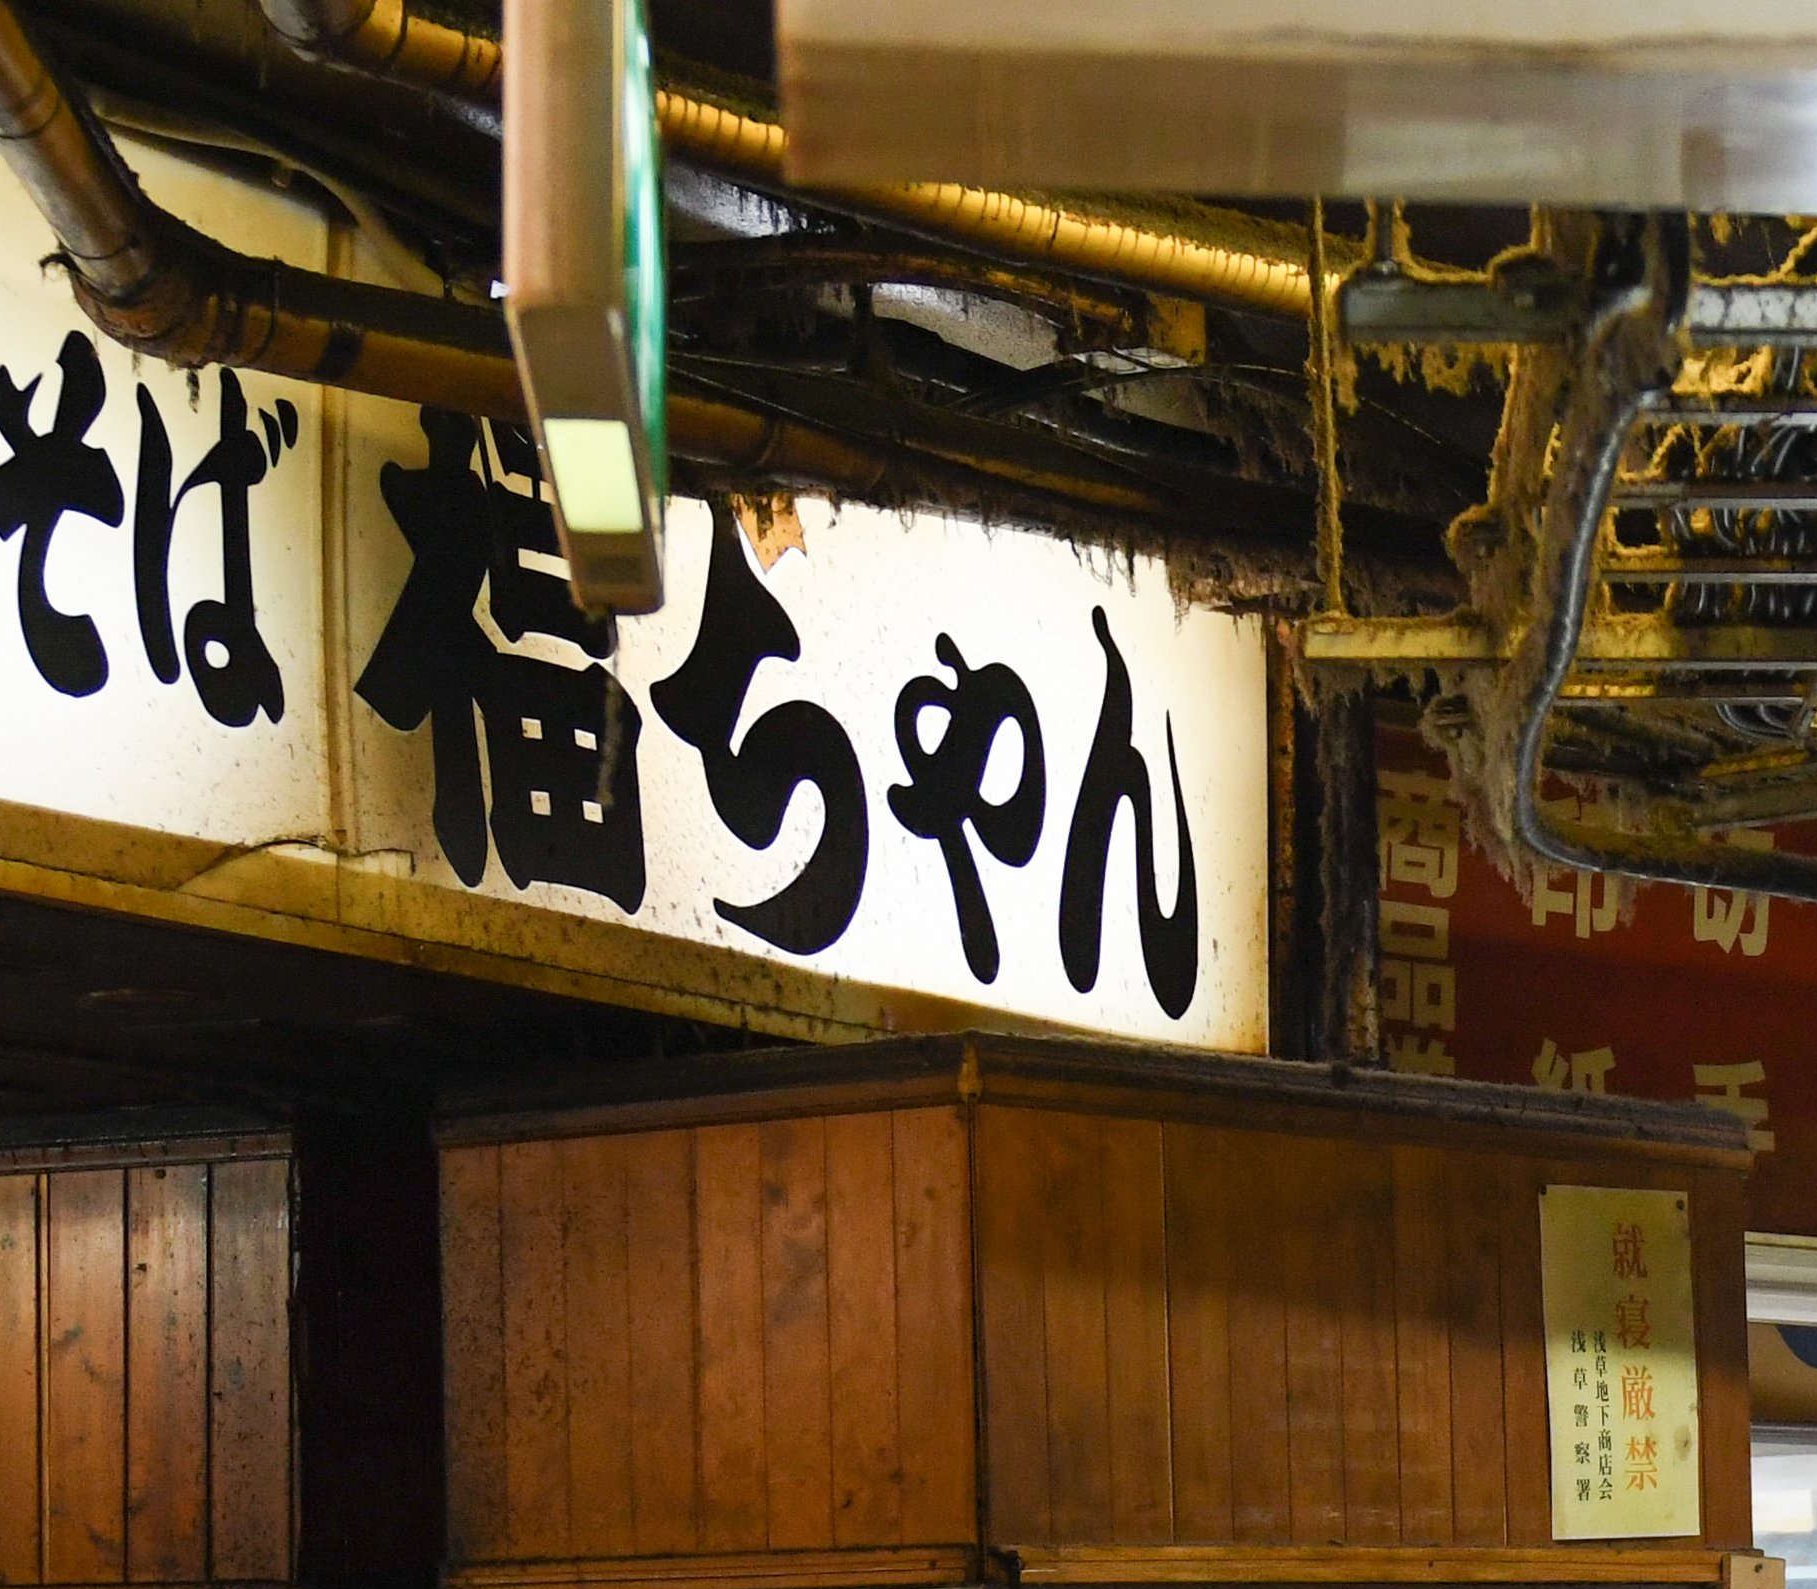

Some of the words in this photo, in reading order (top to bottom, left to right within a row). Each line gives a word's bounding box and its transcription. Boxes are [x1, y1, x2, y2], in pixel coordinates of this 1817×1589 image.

[353, 404, 1200, 1020] 福ちゃん
[1570, 1329, 1592, 1502] 浅草警察署
[1592, 1329, 1613, 1501] 浅草地下商店会
[1611, 1220, 1659, 1492] 就寝厳禁
